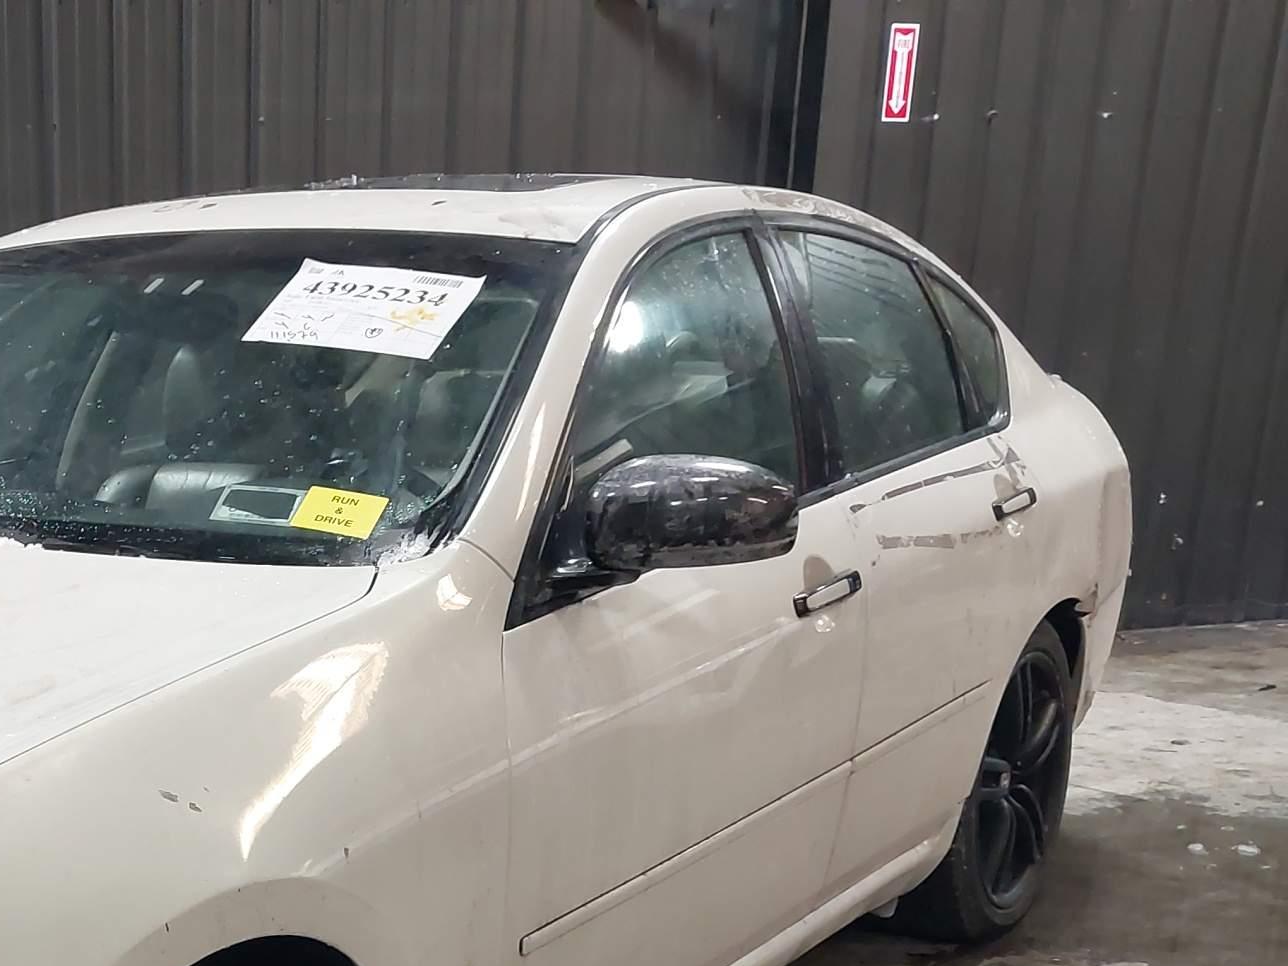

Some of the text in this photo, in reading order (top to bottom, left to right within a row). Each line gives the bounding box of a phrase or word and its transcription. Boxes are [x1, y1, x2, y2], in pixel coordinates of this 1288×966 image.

[303, 280, 448, 306] 43925234
[331, 495, 360, 506] RUN
[314, 514, 353, 527] DRIVE
